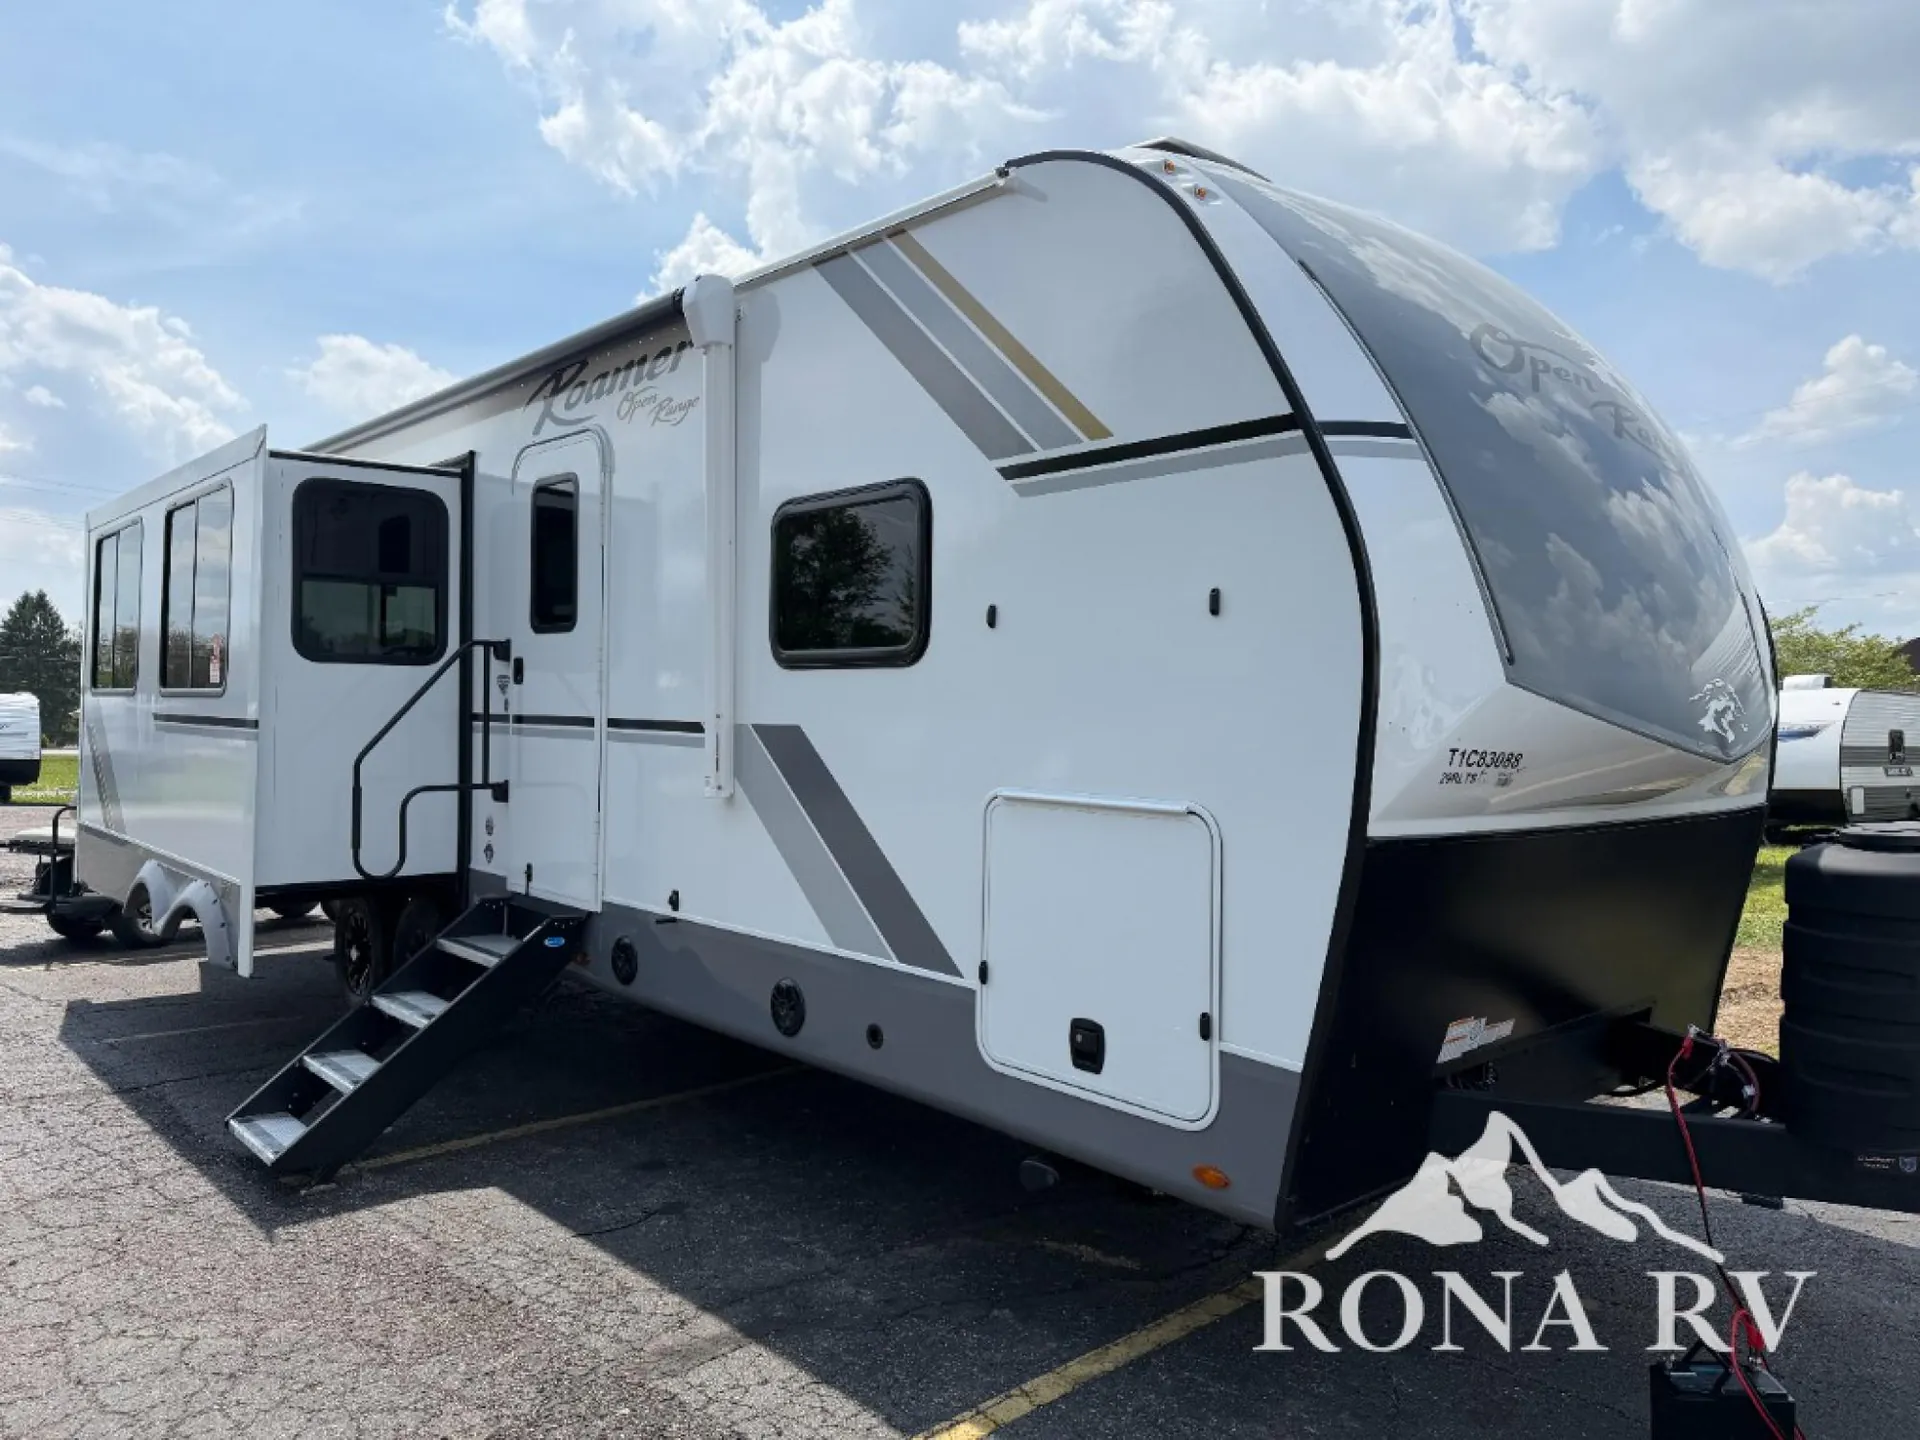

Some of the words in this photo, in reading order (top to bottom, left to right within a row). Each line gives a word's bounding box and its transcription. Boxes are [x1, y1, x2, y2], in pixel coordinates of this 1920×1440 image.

[524, 339, 694, 435] Roamer
[1469, 322, 1598, 394] Open
[616, 385, 659, 425] Open
[648, 395, 701, 427] Range
